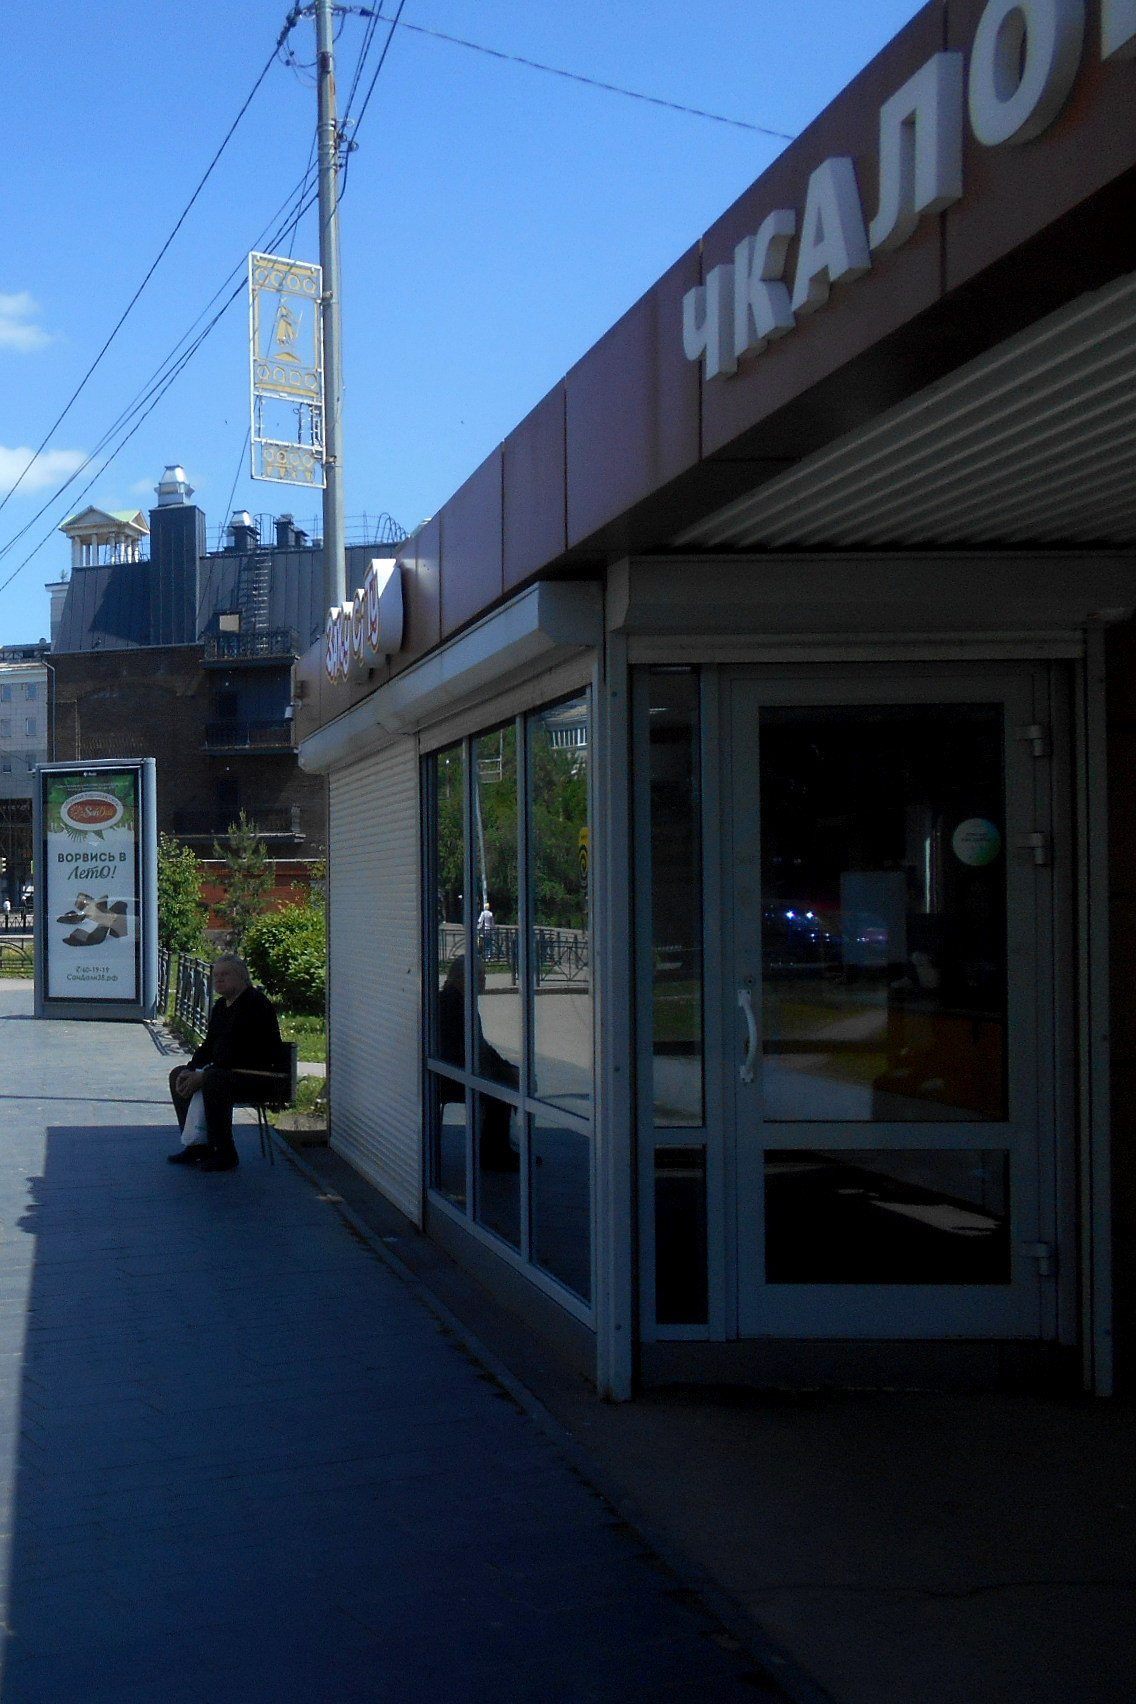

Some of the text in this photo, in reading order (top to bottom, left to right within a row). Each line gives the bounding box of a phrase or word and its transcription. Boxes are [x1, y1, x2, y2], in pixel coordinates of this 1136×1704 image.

[683, 0, 1136, 381] ЧКАЛО
[57, 852, 127, 863] ВОРВИСЬ В
